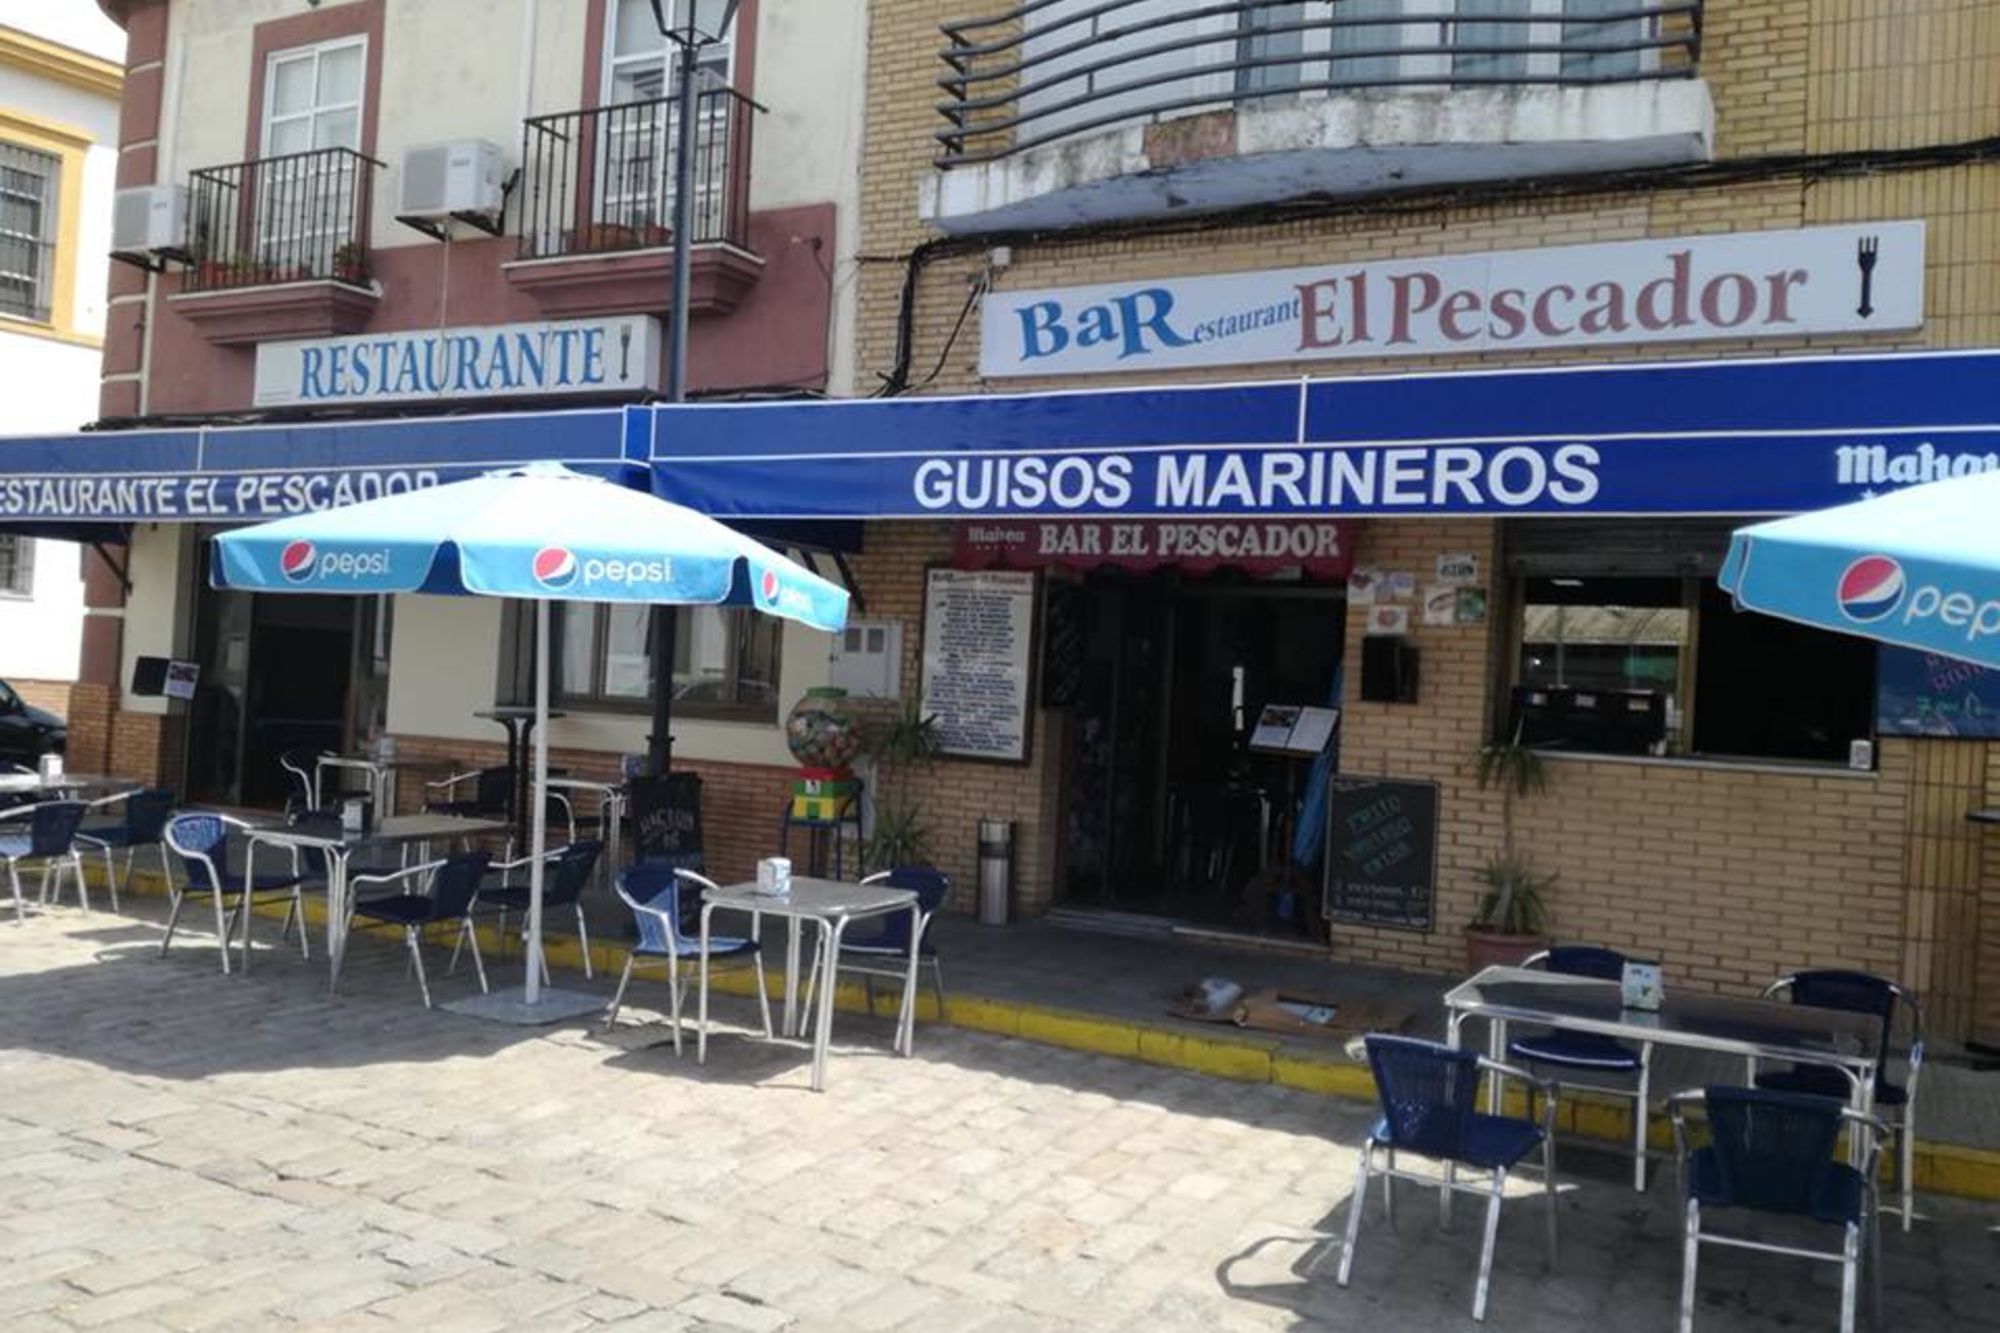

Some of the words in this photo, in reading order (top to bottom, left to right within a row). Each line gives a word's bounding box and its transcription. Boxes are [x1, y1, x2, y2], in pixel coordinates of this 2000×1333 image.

[1294, 271, 1373, 352] El
[1384, 249, 1808, 346] Pescador
[301, 326, 606, 399] RESTAURANTE
[914, 456, 1132, 509] GUISOS
[1155, 443, 1601, 509] MARINEROS
[185, 478, 228, 513] EL
[1038, 523, 1101, 557] BAR
[1109, 524, 1150, 555] EL
[1157, 522, 1339, 556] PESCADOR
[320, 549, 390, 579] pepsi
[584, 556, 672, 584] pepsi
